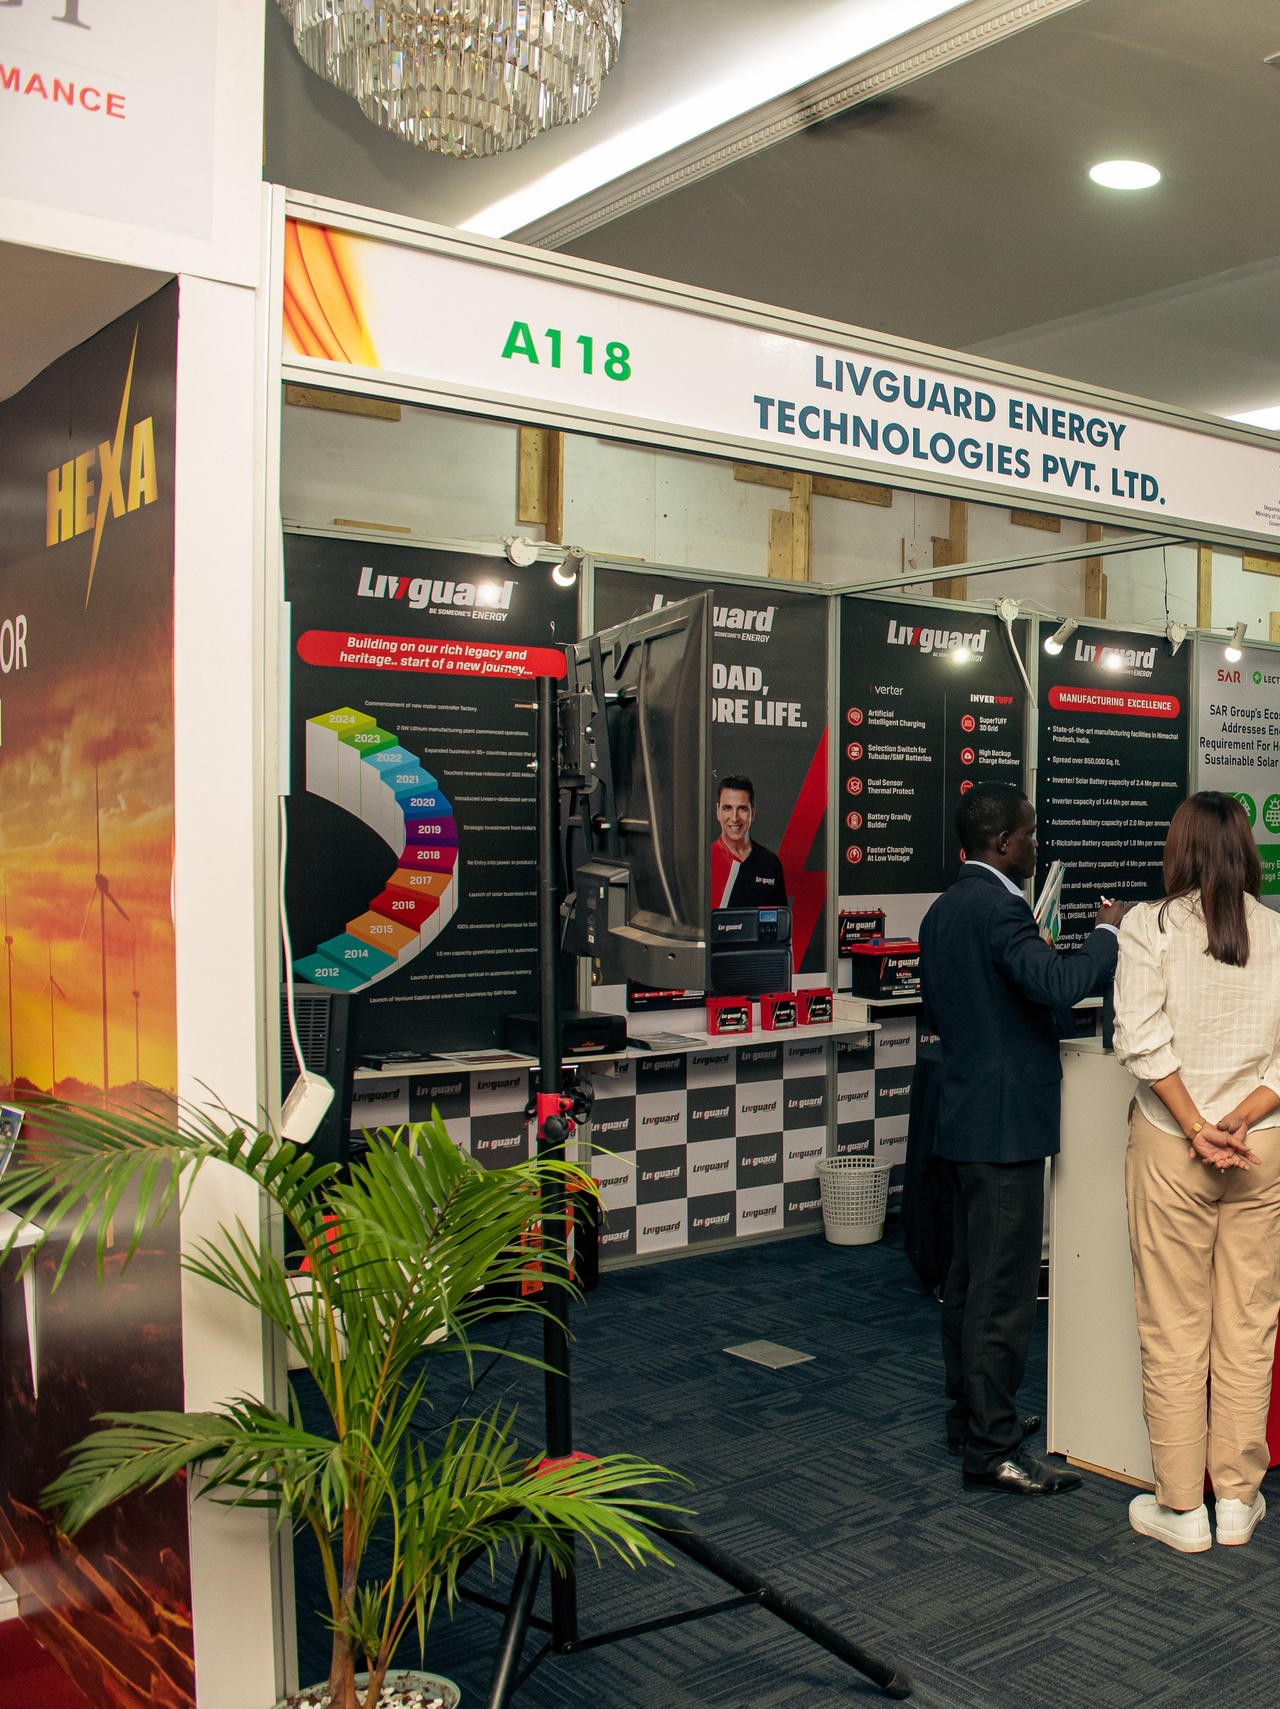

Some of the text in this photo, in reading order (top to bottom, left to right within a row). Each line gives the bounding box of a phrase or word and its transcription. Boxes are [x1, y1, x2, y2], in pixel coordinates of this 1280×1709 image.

[501, 321, 631, 382] A118
[815, 355, 1126, 451] LIVGUARD ENERGY
[753, 395, 1166, 505] TECHNOLOGIES PVT. LTD.
[438, 609, 471, 617] SOMEONE'S
[472, 611, 508, 621] ENERGY
[741, 633, 770, 643] ENERGY
[887, 620, 987, 653] Livguard
[0, 615, 27, 674] OR
[347, 637, 527, 661] Building on our rich legacy and
[340, 652, 533, 677] heritage.. start of a new journey...
[1217, 669, 1241, 683] SAR
[970, 694, 1013, 705] INVERTUFF
[1060, 693, 1171, 711] MANUFACTURING EXCELLENCE
[755, 700, 807, 727] LIFE.
[868, 709, 894, 718] Artificial
[1210, 704, 1227, 716] SAR
[1230, 706, 1261, 721] Group's
[329, 714, 355, 724] 2024
[868, 718, 926, 729] Intelligent Charging
[1221, 722, 1266, 735] Addresses
[354, 734, 380, 743] 2023
[1200, 737, 1254, 751] Requirement
[1257, 740, 1270, 751] For
[868, 744, 897, 753] Selection
[376, 753, 402, 763] 2022
[868, 753, 932, 762] Tubular/SMF Batteries
[1205, 754, 1254, 767] Sustainable
[1257, 756, 1278, 767] Solar
[396, 774, 419, 784] 2021
[882, 779, 903, 787] Sensor
[868, 787, 894, 795] Thermal
[410, 797, 435, 807] 2020
[868, 813, 912, 822] Battery Gravity
[418, 825, 441, 834] 2019
[417, 851, 440, 860] 2018
[410, 876, 432, 885] 2017
[392, 901, 415, 910] 2016
[370, 925, 393, 934] 2015
[718, 923, 743, 932] Livguard
[846, 920, 877, 931] Livguard
[344, 949, 368, 959] 2014
[314, 967, 339, 977] 2012
[880, 1037, 910, 1047] Livguard
[642, 1112, 680, 1125] Livguard
[477, 1135, 521, 1150] Livguard
[789, 1147, 823, 1159] Livguard
[693, 1160, 729, 1173] Livguard
[693, 1213, 730, 1226] Livguard
